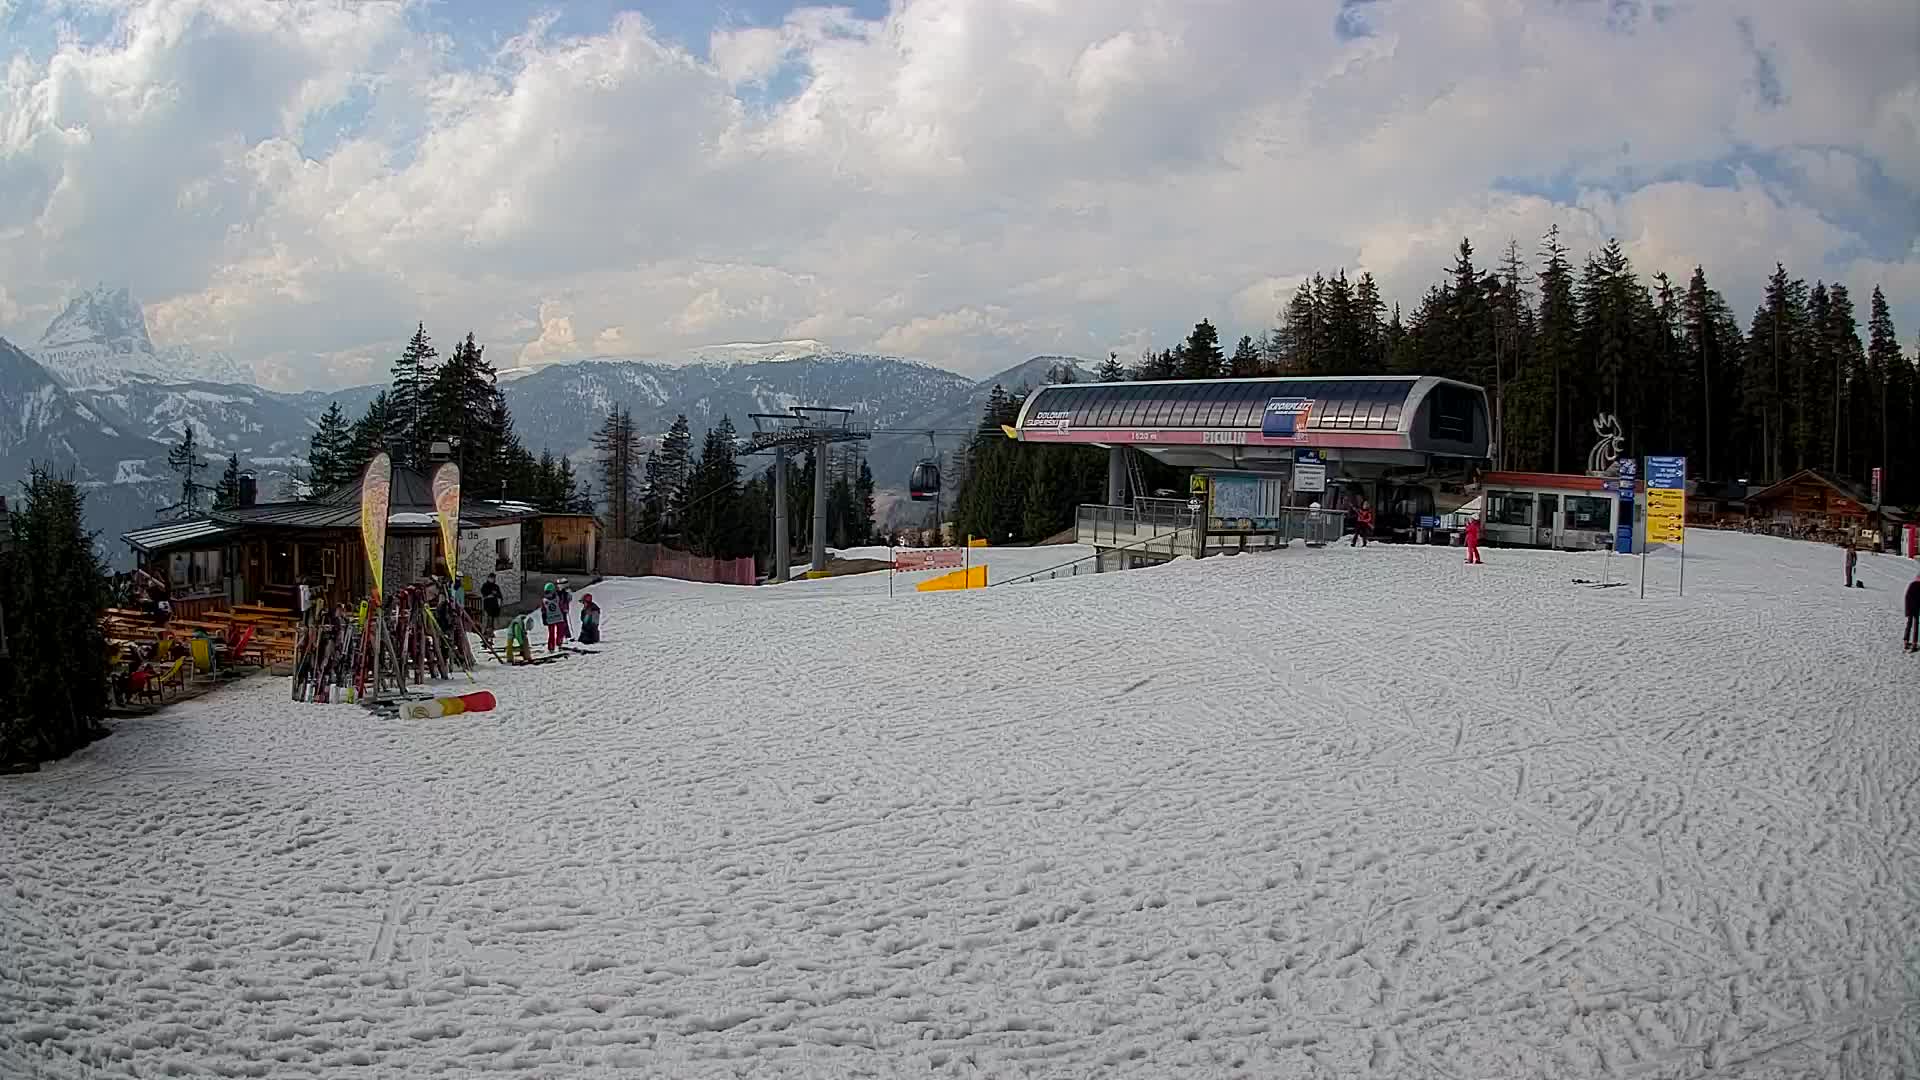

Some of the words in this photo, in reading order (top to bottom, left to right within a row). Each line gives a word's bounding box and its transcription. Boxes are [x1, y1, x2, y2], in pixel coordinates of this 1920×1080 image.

[1267, 402, 1311, 410] KRONPLATZ
[1036, 411, 1069, 419] DOLOMITI
[1202, 432, 1247, 444] PICULIN
